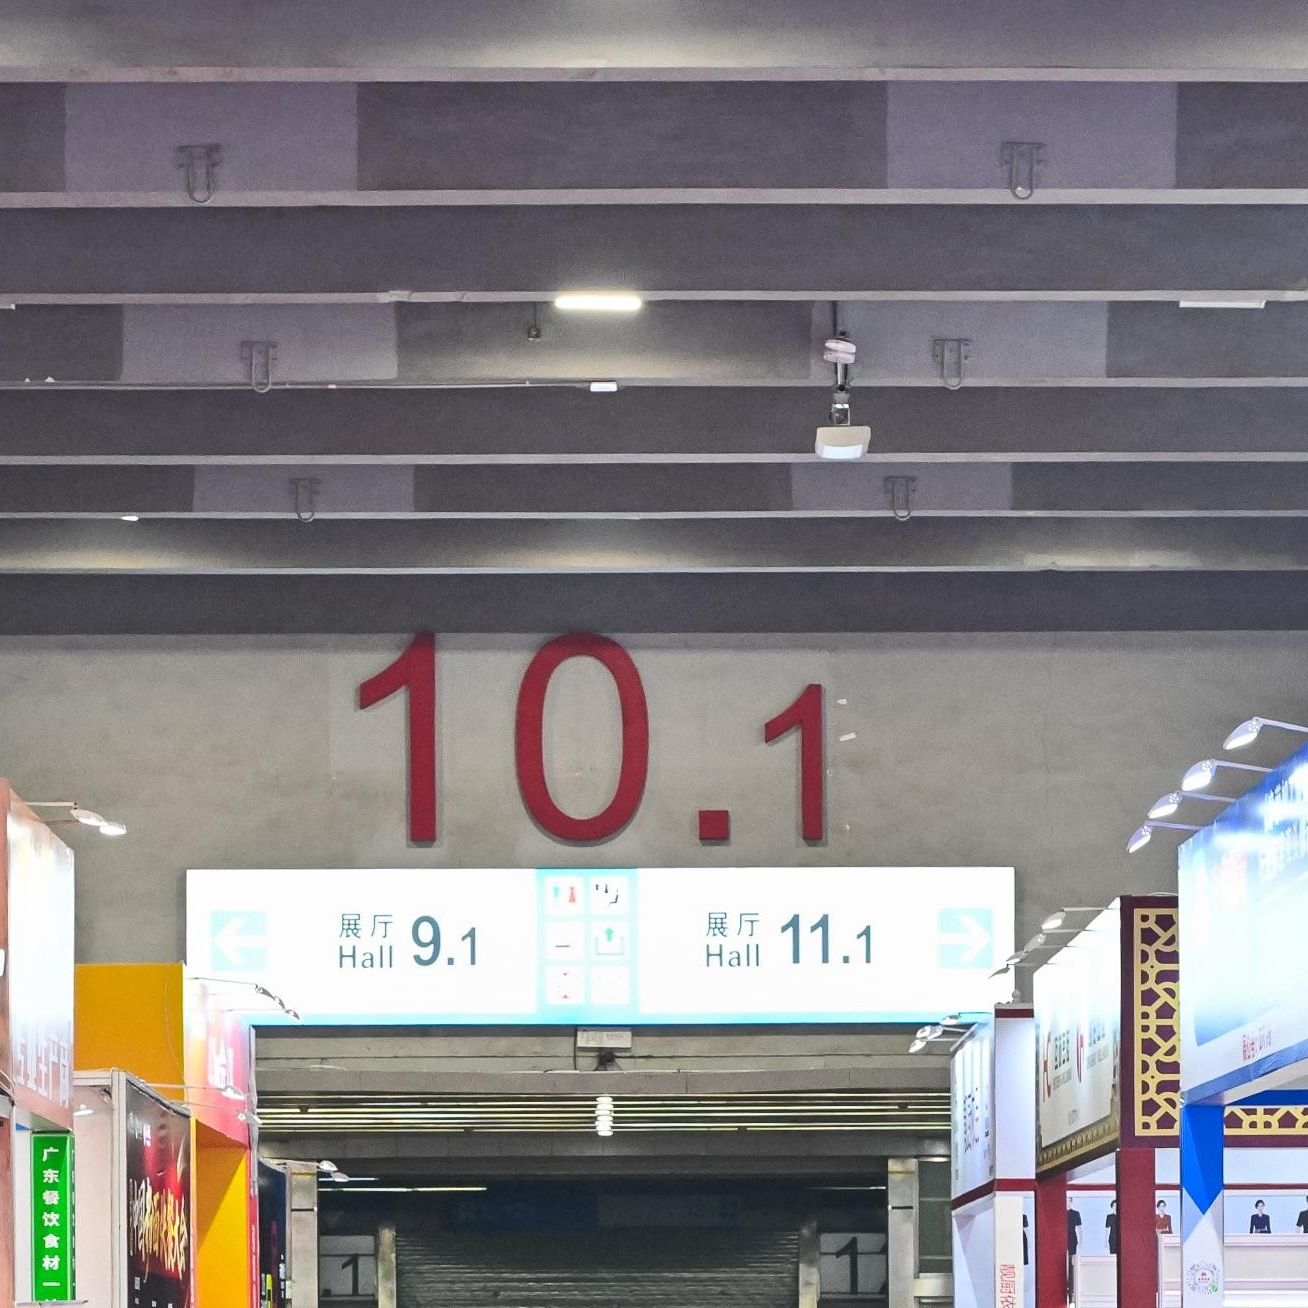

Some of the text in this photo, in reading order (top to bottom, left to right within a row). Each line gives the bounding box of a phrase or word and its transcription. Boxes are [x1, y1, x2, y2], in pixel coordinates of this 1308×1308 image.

[358, 631, 824, 842] 10.1
[338, 913, 395, 941] 展厅
[338, 915, 478, 970] Hall 9.1
[706, 911, 760, 939] 展厅
[706, 914, 874, 969] Hall 11.1
[42, 1145, 61, 1301] 广东餐饮食材一
